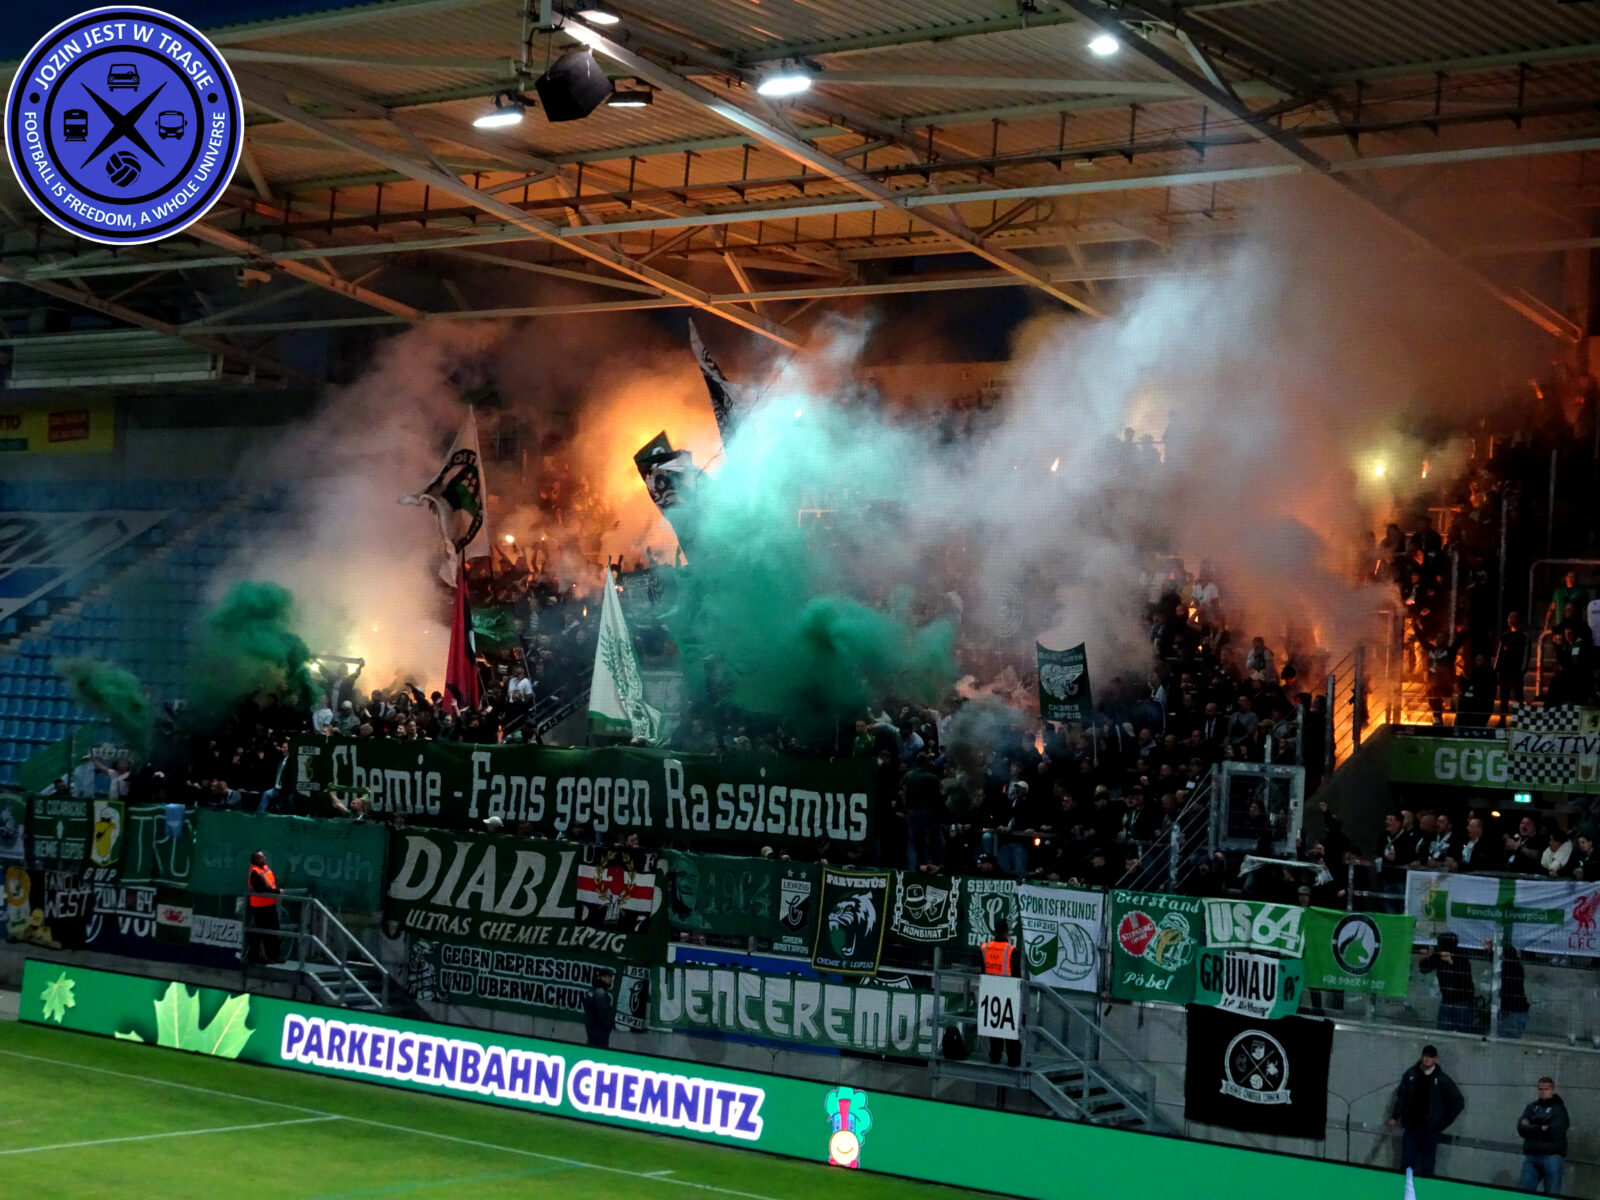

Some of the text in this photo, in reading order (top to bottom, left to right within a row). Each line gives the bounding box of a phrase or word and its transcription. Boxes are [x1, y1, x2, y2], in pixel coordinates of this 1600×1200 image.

[331, 744, 442, 817] Chemie
[467, 751, 547, 822] Fans
[554, 776, 653, 833] gegen
[663, 758, 868, 842] Rassismus
[44, 889, 92, 919] WEST
[1019, 894, 1098, 921] SPORTSFREUNDE
[1466, 906, 1549, 922] Fanclub Liverpool
[405, 908, 472, 936] ULTRAS
[478, 920, 553, 946] CHEMIE
[902, 926, 942, 940] KOMBINAT
[1209, 901, 1304, 950] US64
[442, 945, 491, 969] GEGEN
[1568, 936, 1597, 950] LFC
[441, 969, 473, 994] UND
[1122, 970, 1175, 991] Pöbel
[1201, 951, 1276, 1002] GRÜNAU
[980, 995, 1016, 1031] 19A
[284, 1017, 764, 1137] PARKEISENBAHN CHEMNITZ
